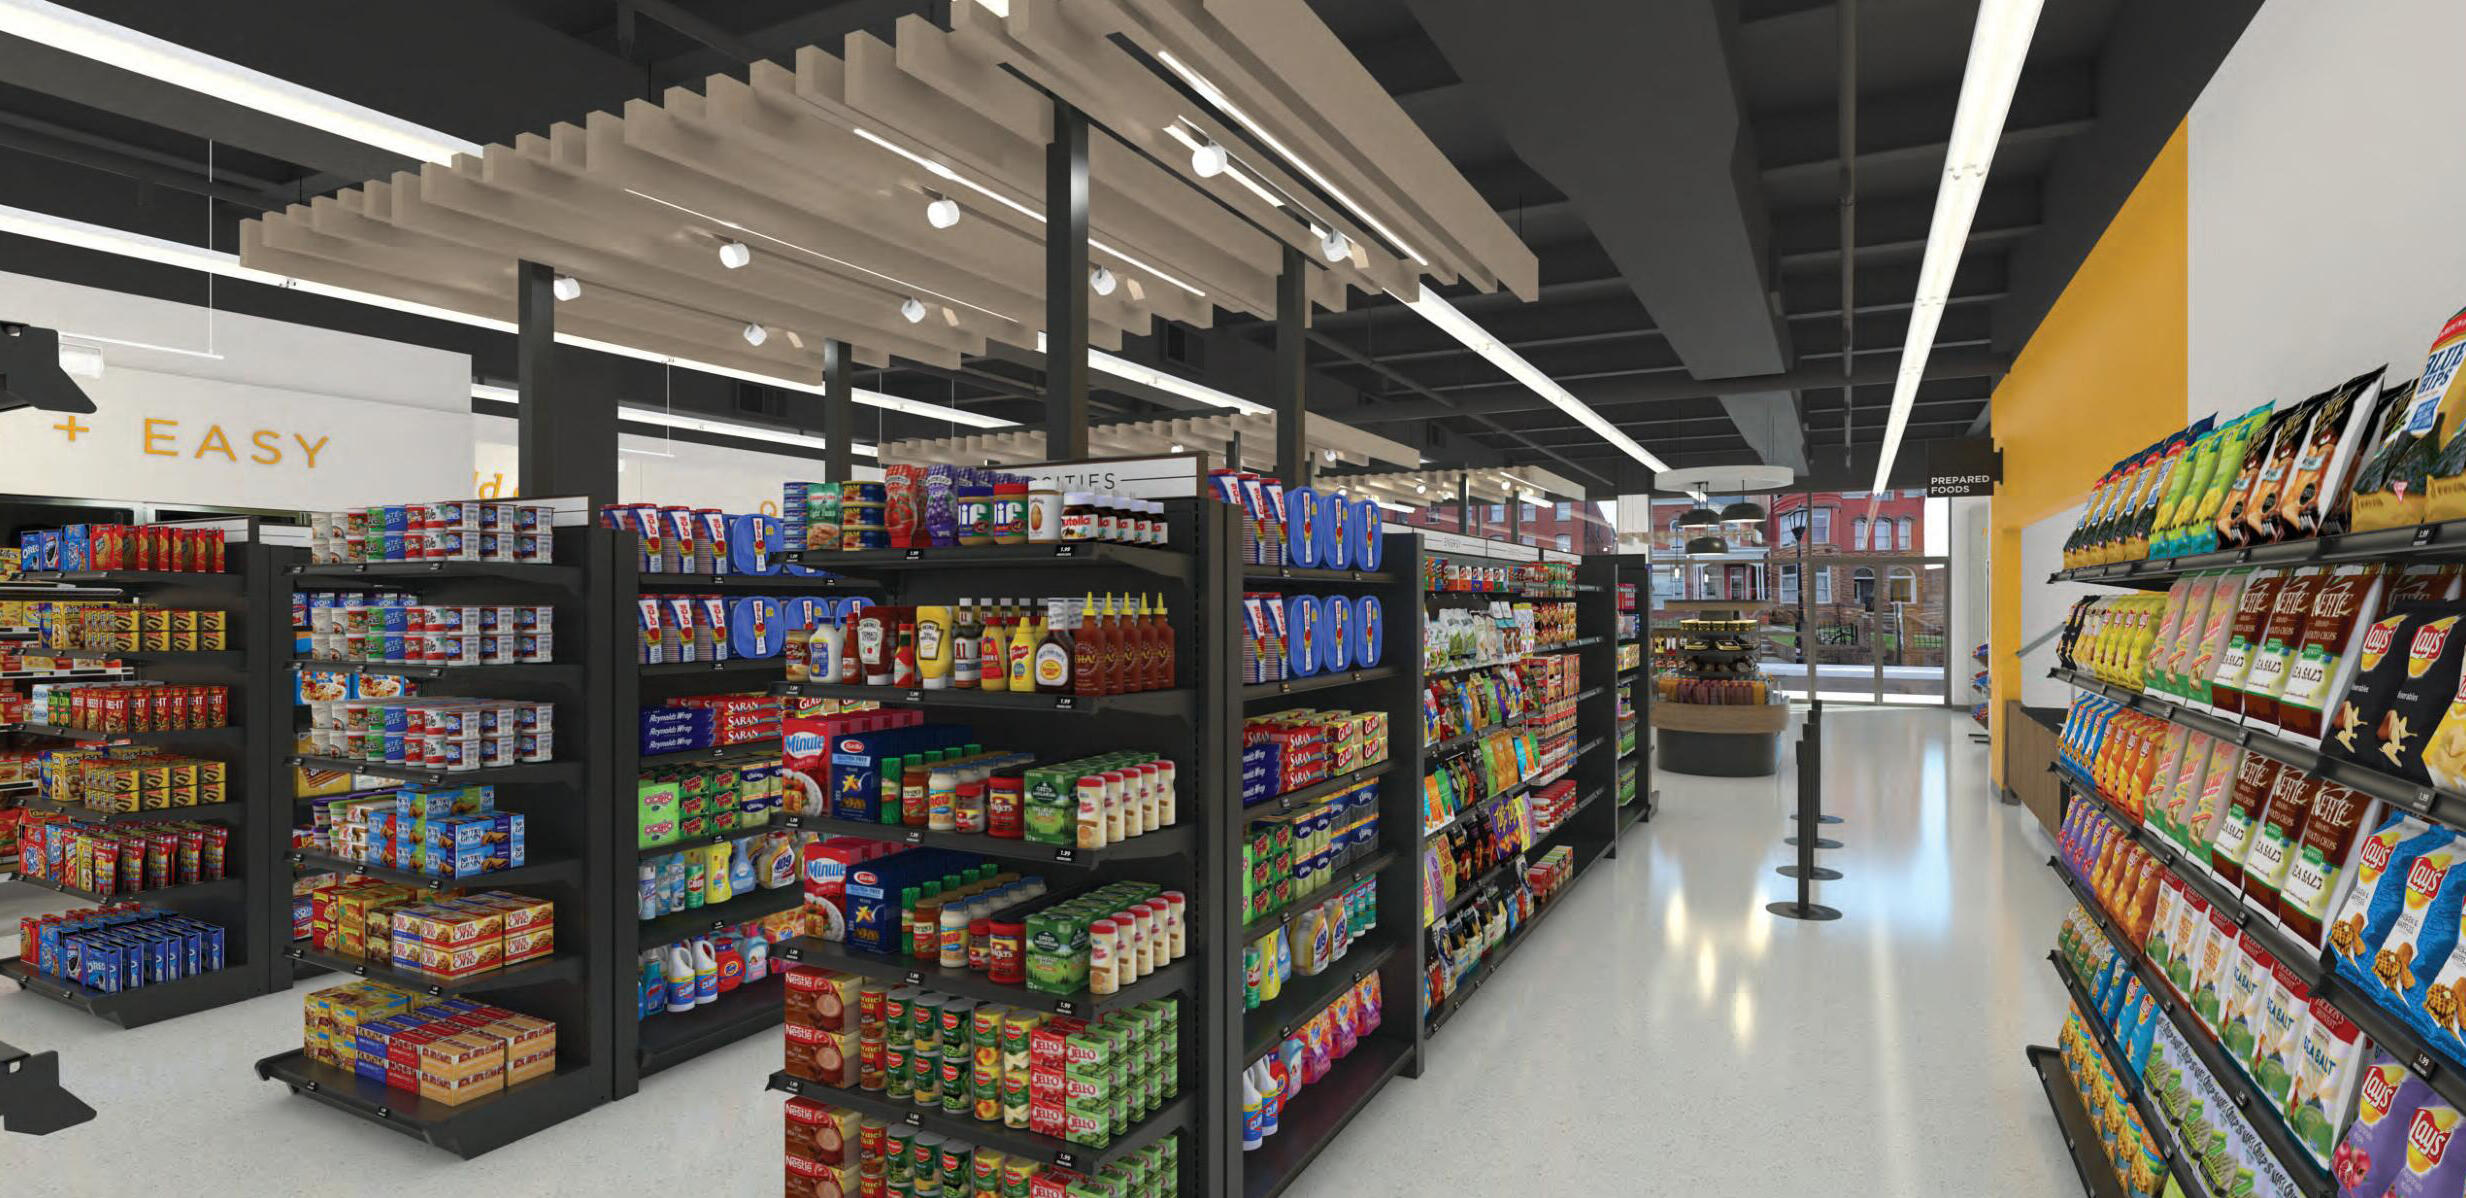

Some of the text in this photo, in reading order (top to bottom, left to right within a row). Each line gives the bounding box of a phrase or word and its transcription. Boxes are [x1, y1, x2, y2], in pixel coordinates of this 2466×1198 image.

[144, 418, 329, 468] EASY
[1931, 475, 1990, 485] PREPARED
[1931, 486, 1970, 494] FOODS
[728, 702, 758, 712] SARAN
[728, 716, 758, 727] SARAN
[1365, 715, 1379, 734] GLAD
[728, 730, 758, 740] SARAN
[1290, 733, 1310, 747] SARAN
[786, 736, 825, 753] Minute
[1365, 740, 1379, 758] GLAD
[1290, 752, 1310, 765] SARAN
[1290, 770, 1310, 784] SARAN
[808, 861, 846, 878] Minute
